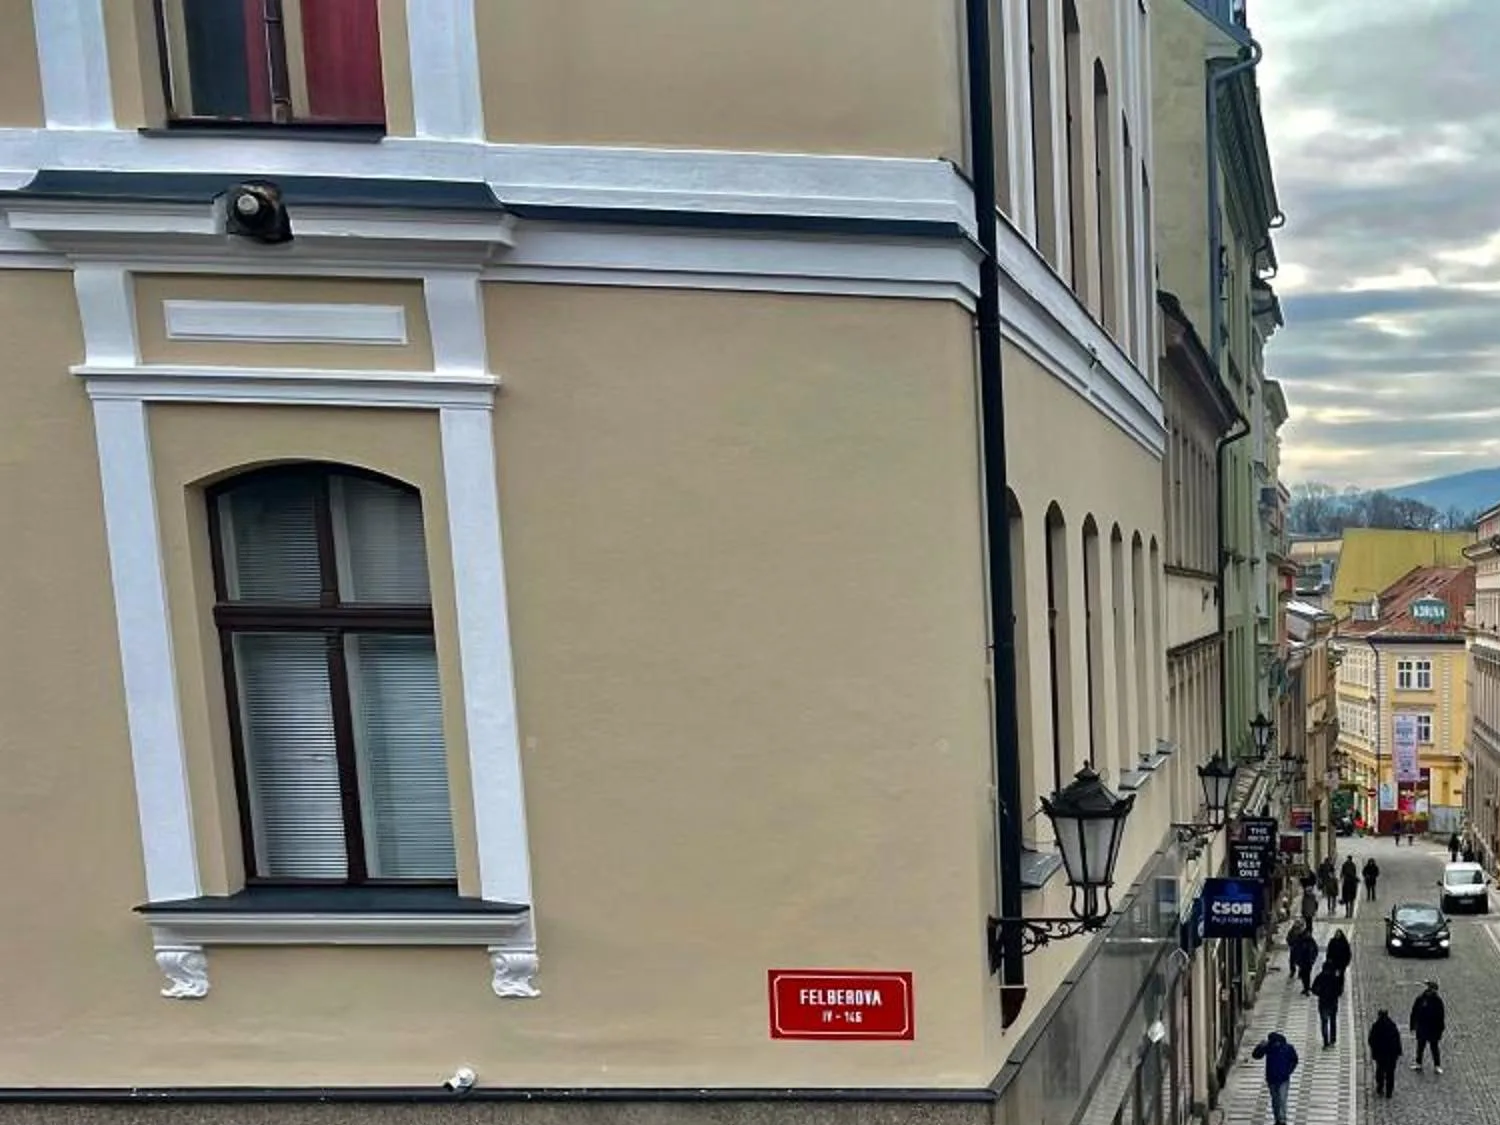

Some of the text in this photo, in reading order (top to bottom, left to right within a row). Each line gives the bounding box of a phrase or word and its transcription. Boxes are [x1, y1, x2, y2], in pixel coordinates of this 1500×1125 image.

[1239, 851, 1259, 860] THE
[1237, 861, 1262, 869] BEST
[1239, 869, 1260, 877] ONE
[799, 988, 883, 1006] FELBEROVA
